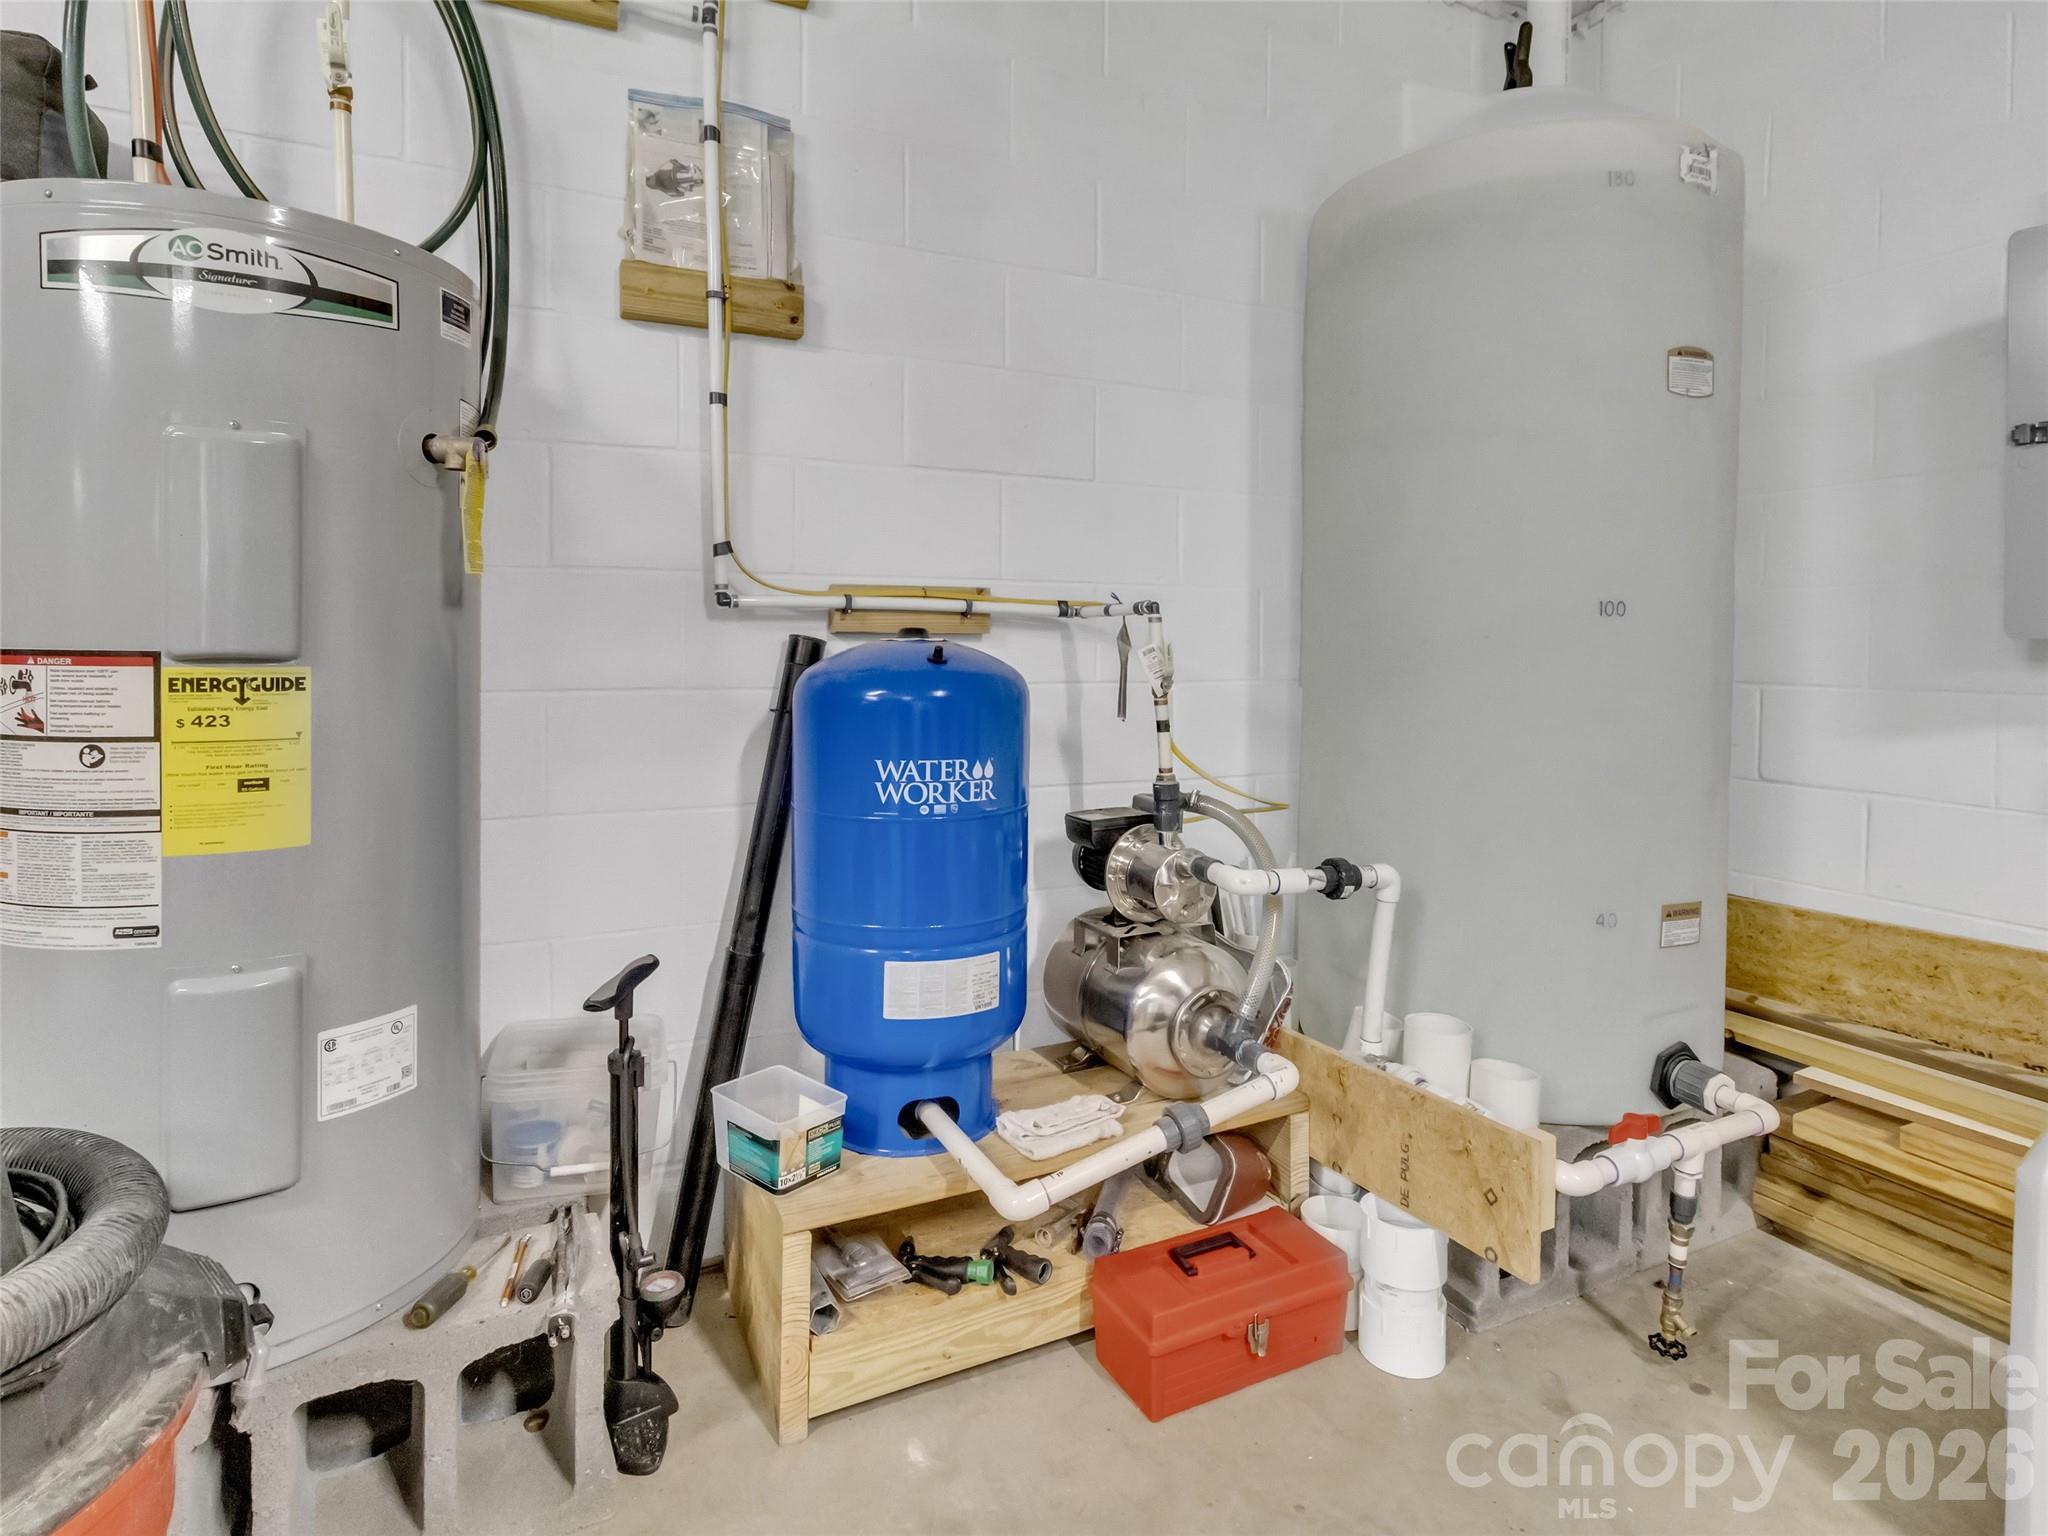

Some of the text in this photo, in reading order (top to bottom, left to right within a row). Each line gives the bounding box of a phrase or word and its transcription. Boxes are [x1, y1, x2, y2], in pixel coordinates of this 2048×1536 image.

[1607, 170, 1637, 187] 180
[198, 270, 258, 286] Signature
[1599, 600, 1627, 617] 100
[37, 657, 72, 665] DANGER
[168, 676, 307, 693] ENERGYGUIDE
[190, 714, 231, 728] 423
[874, 758, 973, 782] WATER
[874, 779, 997, 805] WORKER
[1595, 913, 1618, 928] 40
[1400, 1186, 1410, 1208] DE
